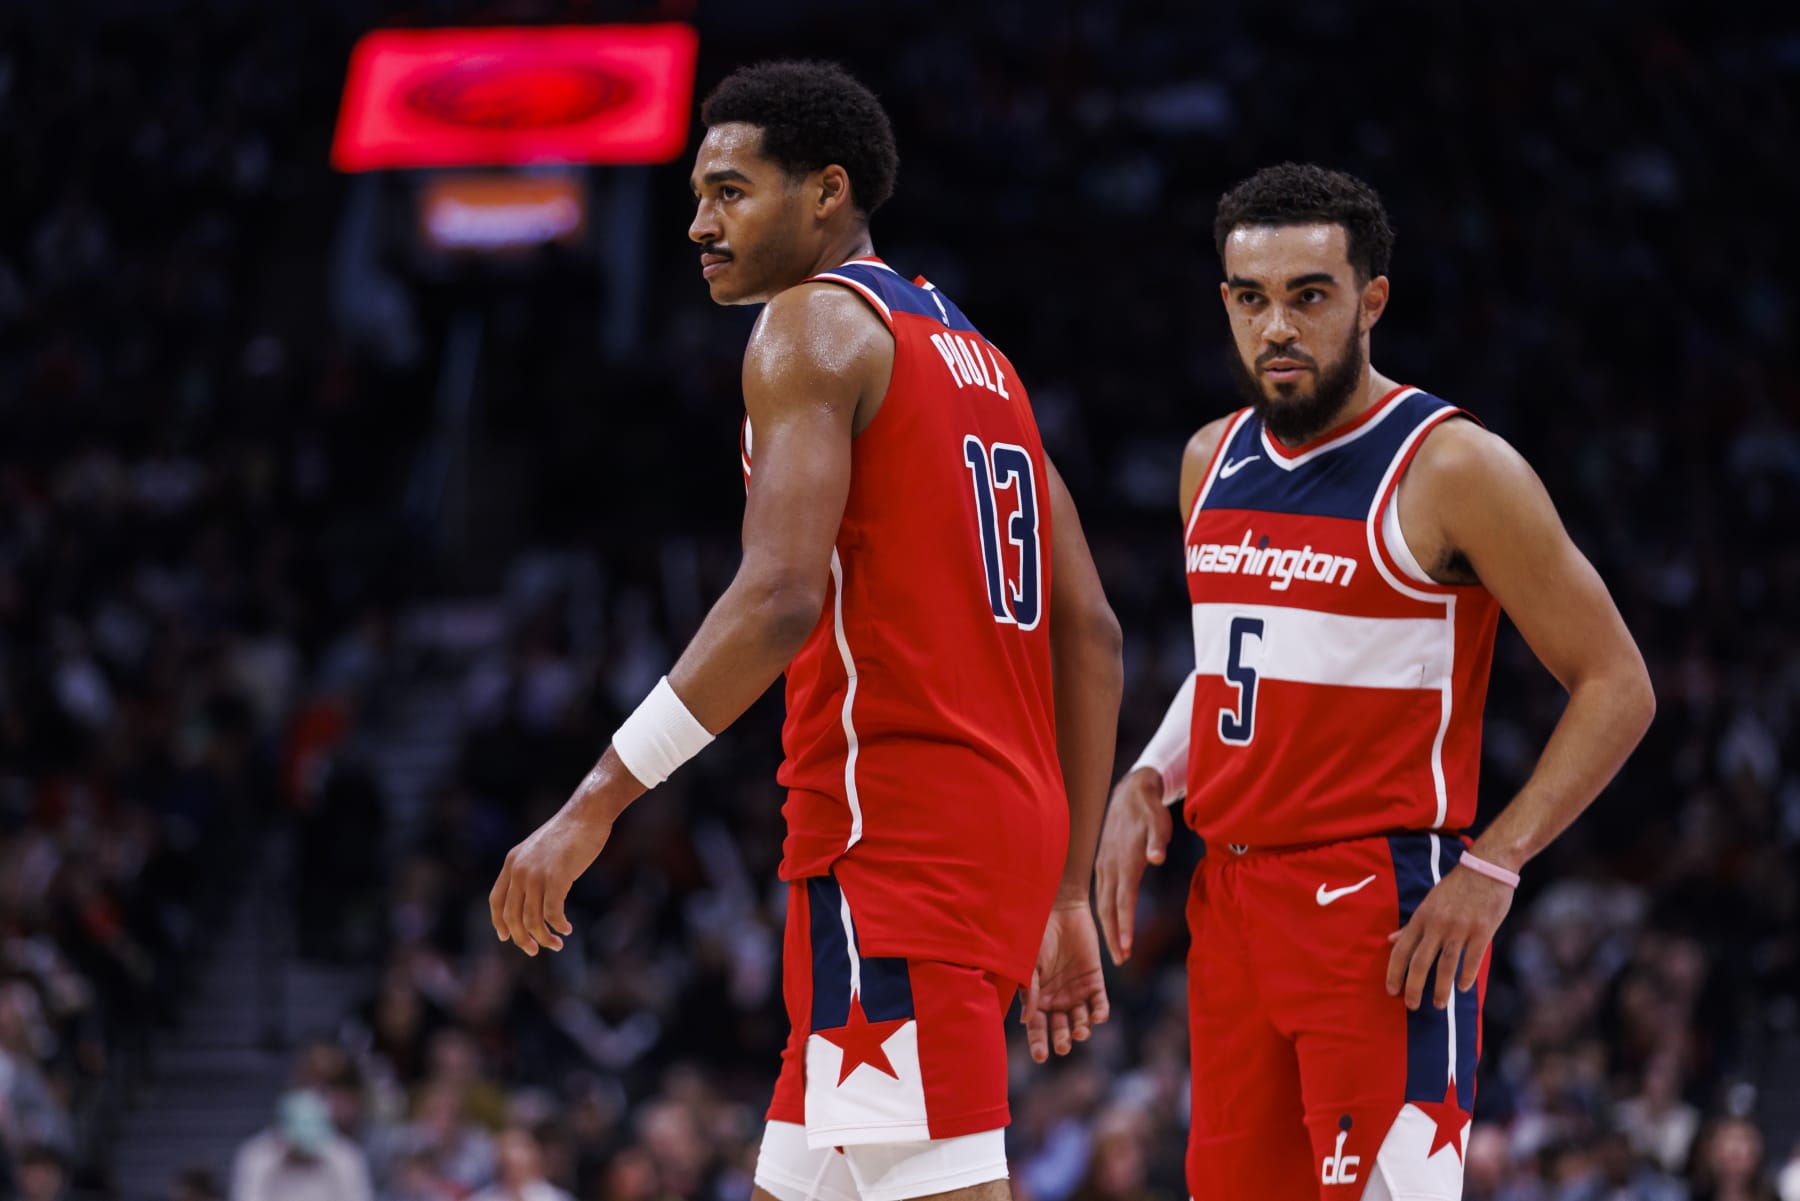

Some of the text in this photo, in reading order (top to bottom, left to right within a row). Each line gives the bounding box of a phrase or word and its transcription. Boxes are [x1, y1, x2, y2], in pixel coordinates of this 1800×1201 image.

[929, 331, 1009, 400] POOLE
[963, 434, 1042, 631] 13
[1186, 528, 1357, 591] washington
[1218, 615, 1265, 746] 5
[1322, 1130, 1360, 1185] dc
